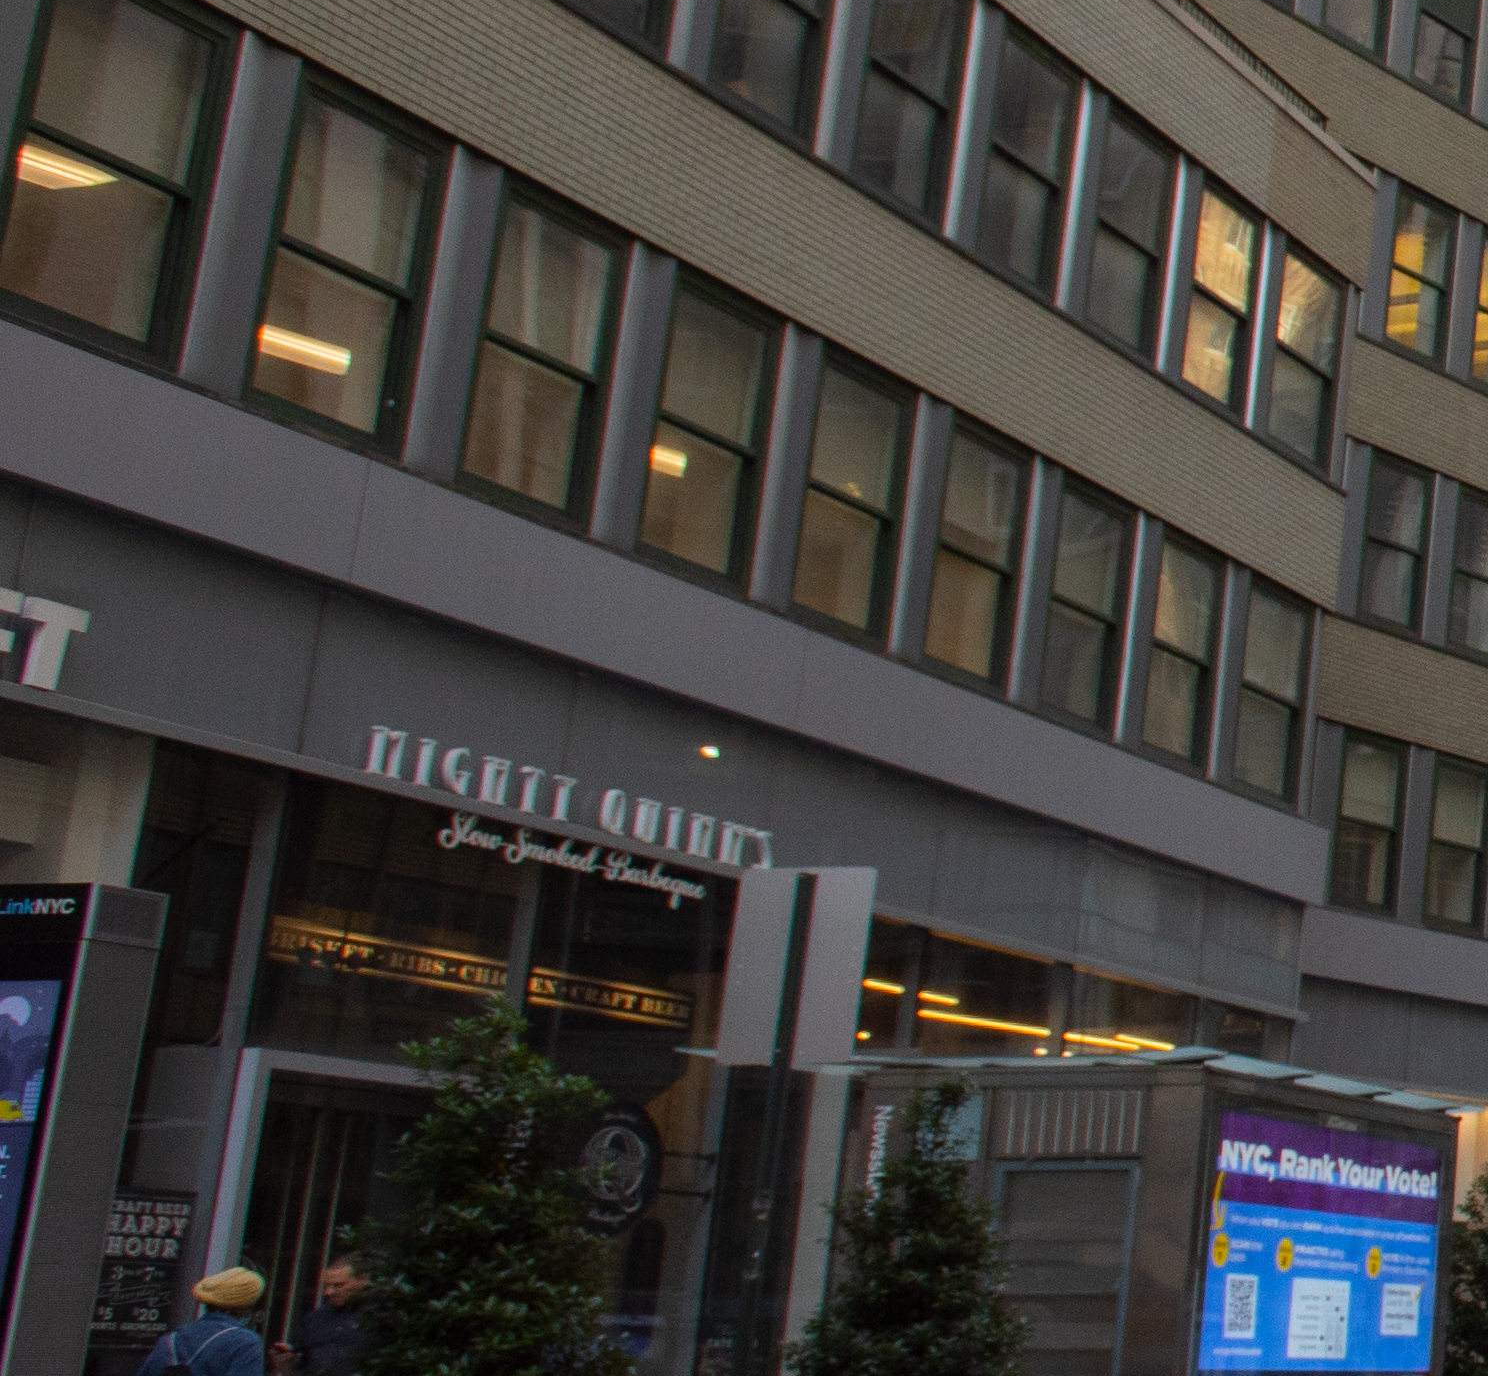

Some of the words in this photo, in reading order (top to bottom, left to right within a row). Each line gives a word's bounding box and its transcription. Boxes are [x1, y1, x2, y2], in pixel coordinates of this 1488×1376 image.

[1220, 1138, 1276, 1183] NYC,
[1279, 1148, 1336, 1184] Rank
[1338, 1157, 1385, 1191] Your
[1385, 1165, 1438, 1198] Vote!
[105, 1235, 180, 1258] HOUR
